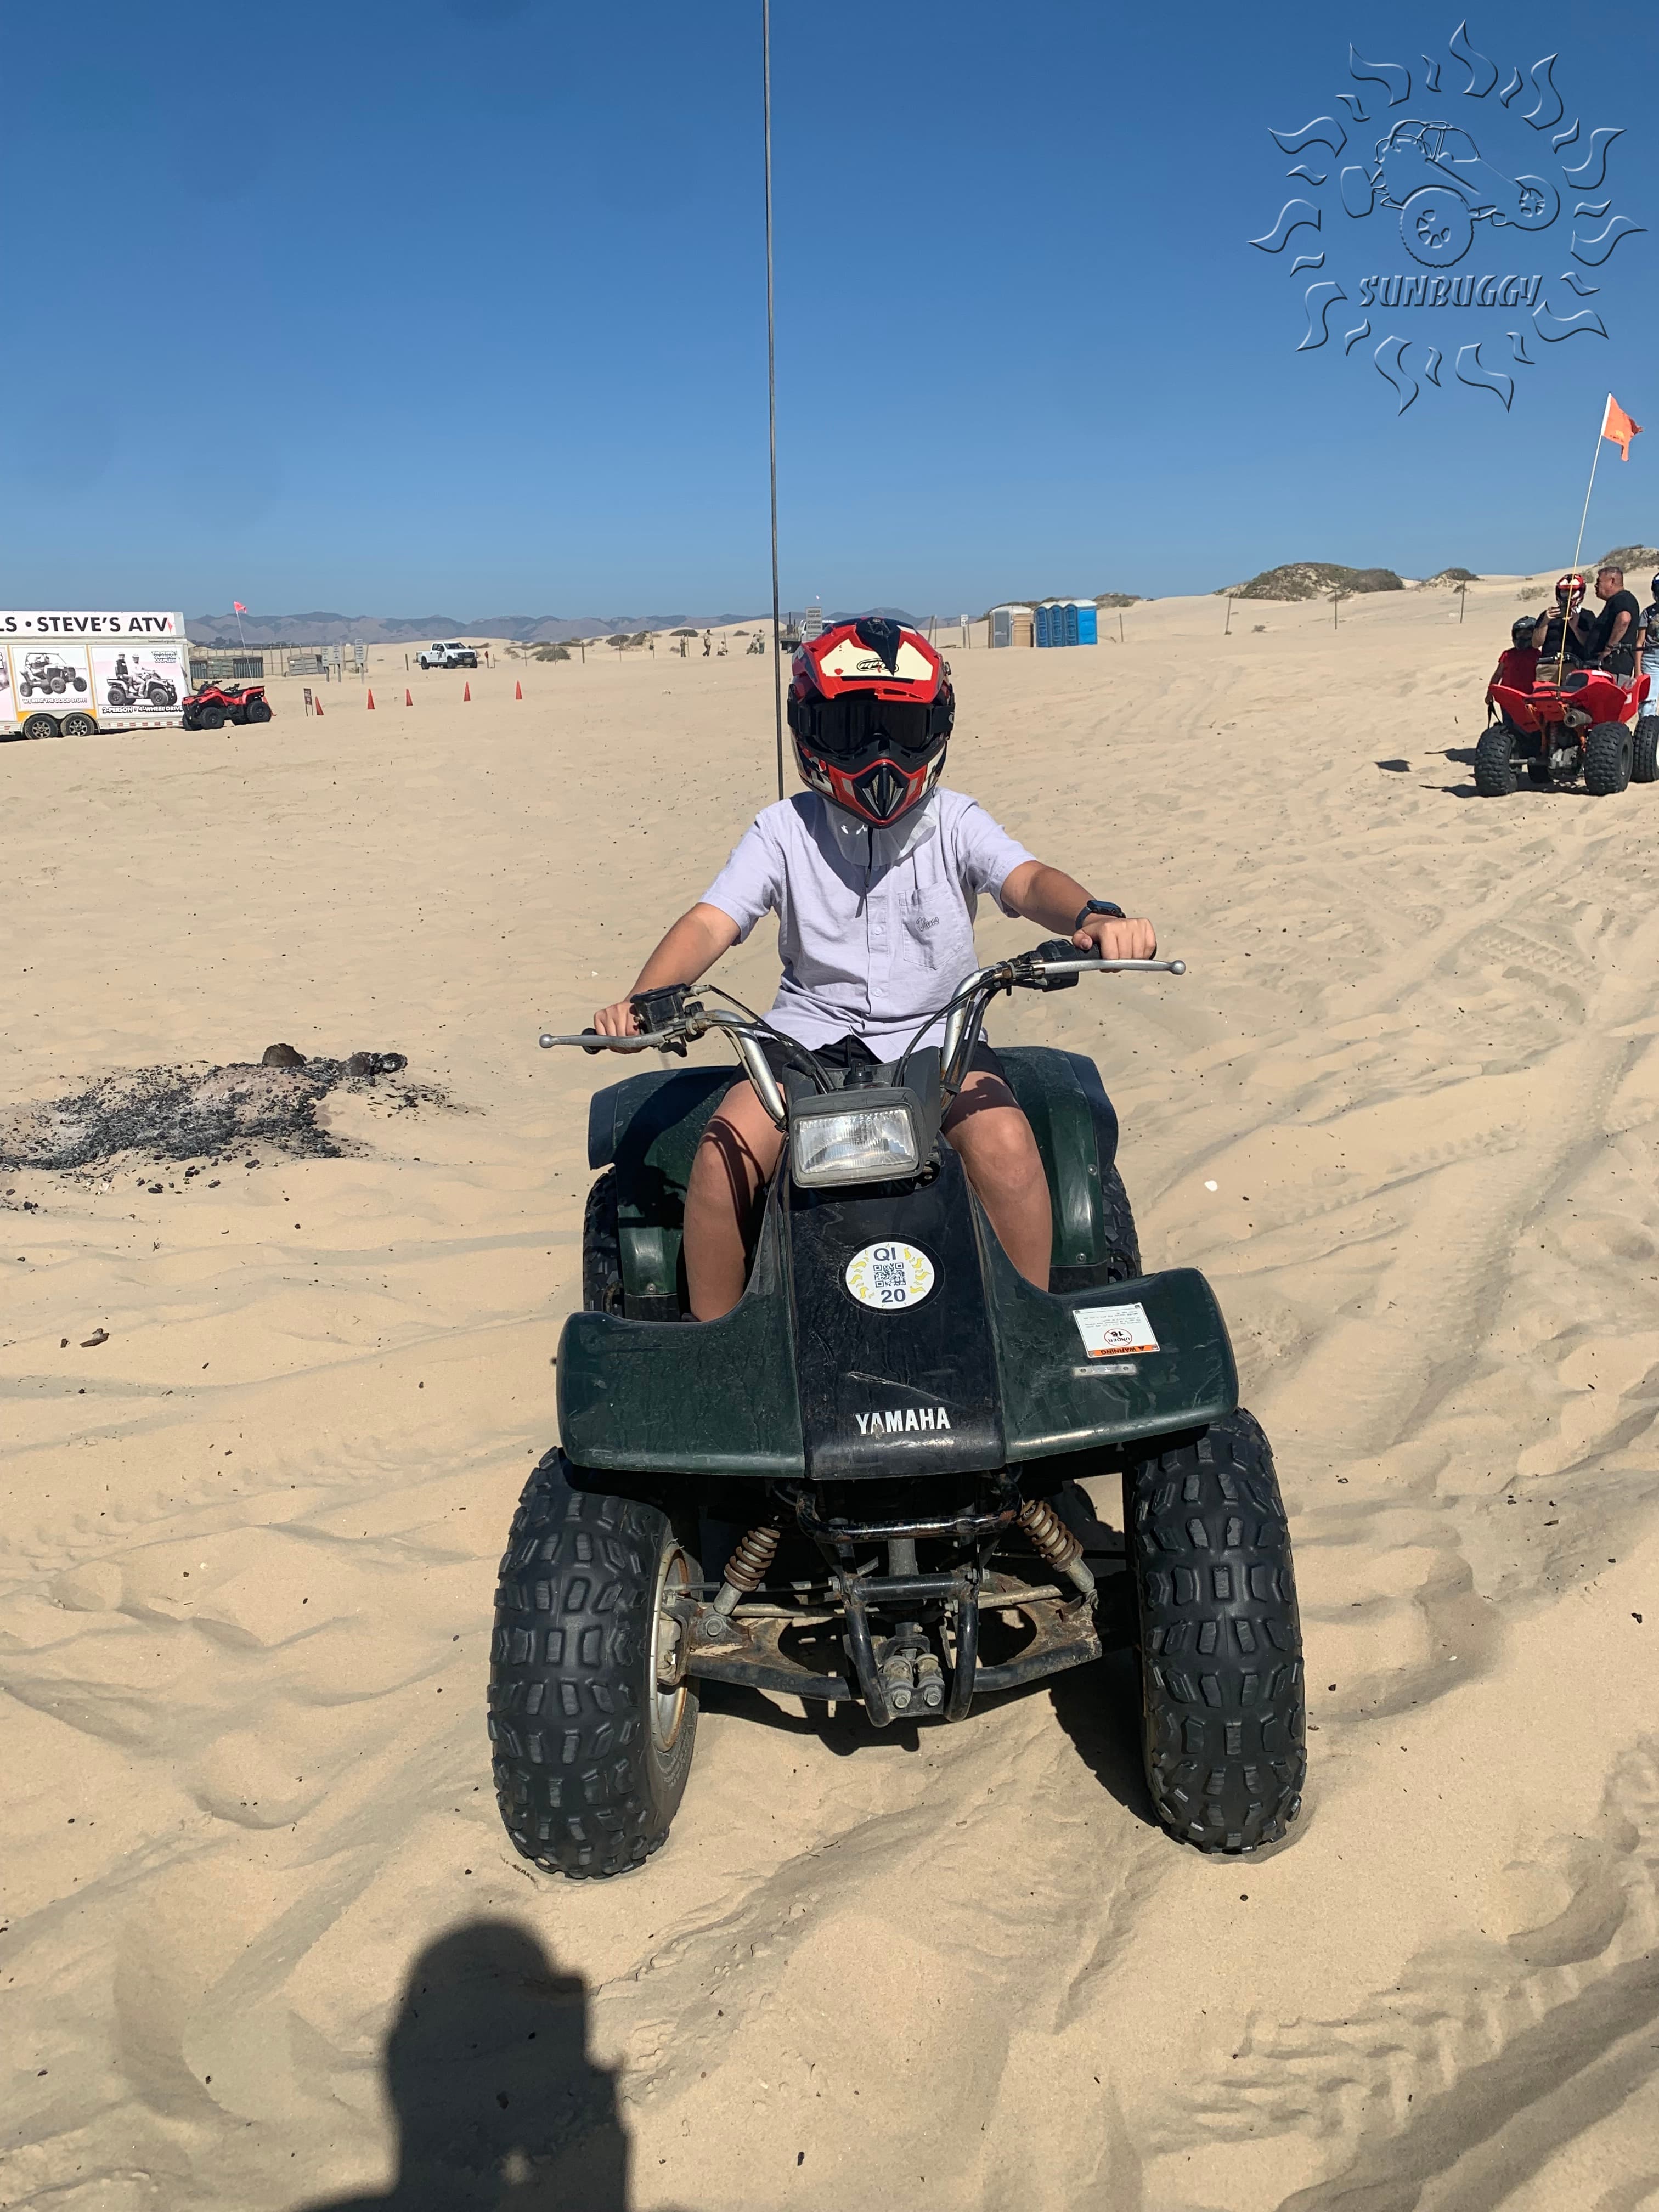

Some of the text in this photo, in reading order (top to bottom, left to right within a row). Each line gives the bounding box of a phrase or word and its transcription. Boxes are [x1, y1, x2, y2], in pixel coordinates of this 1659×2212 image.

[37, 616, 121, 632] STEVE'S
[916, 917, 939, 932] Vans
[881, 1289, 906, 1303] 20
[1101, 1346, 1137, 1355] WARNING
[855, 1407, 951, 1435] YAMAHA
